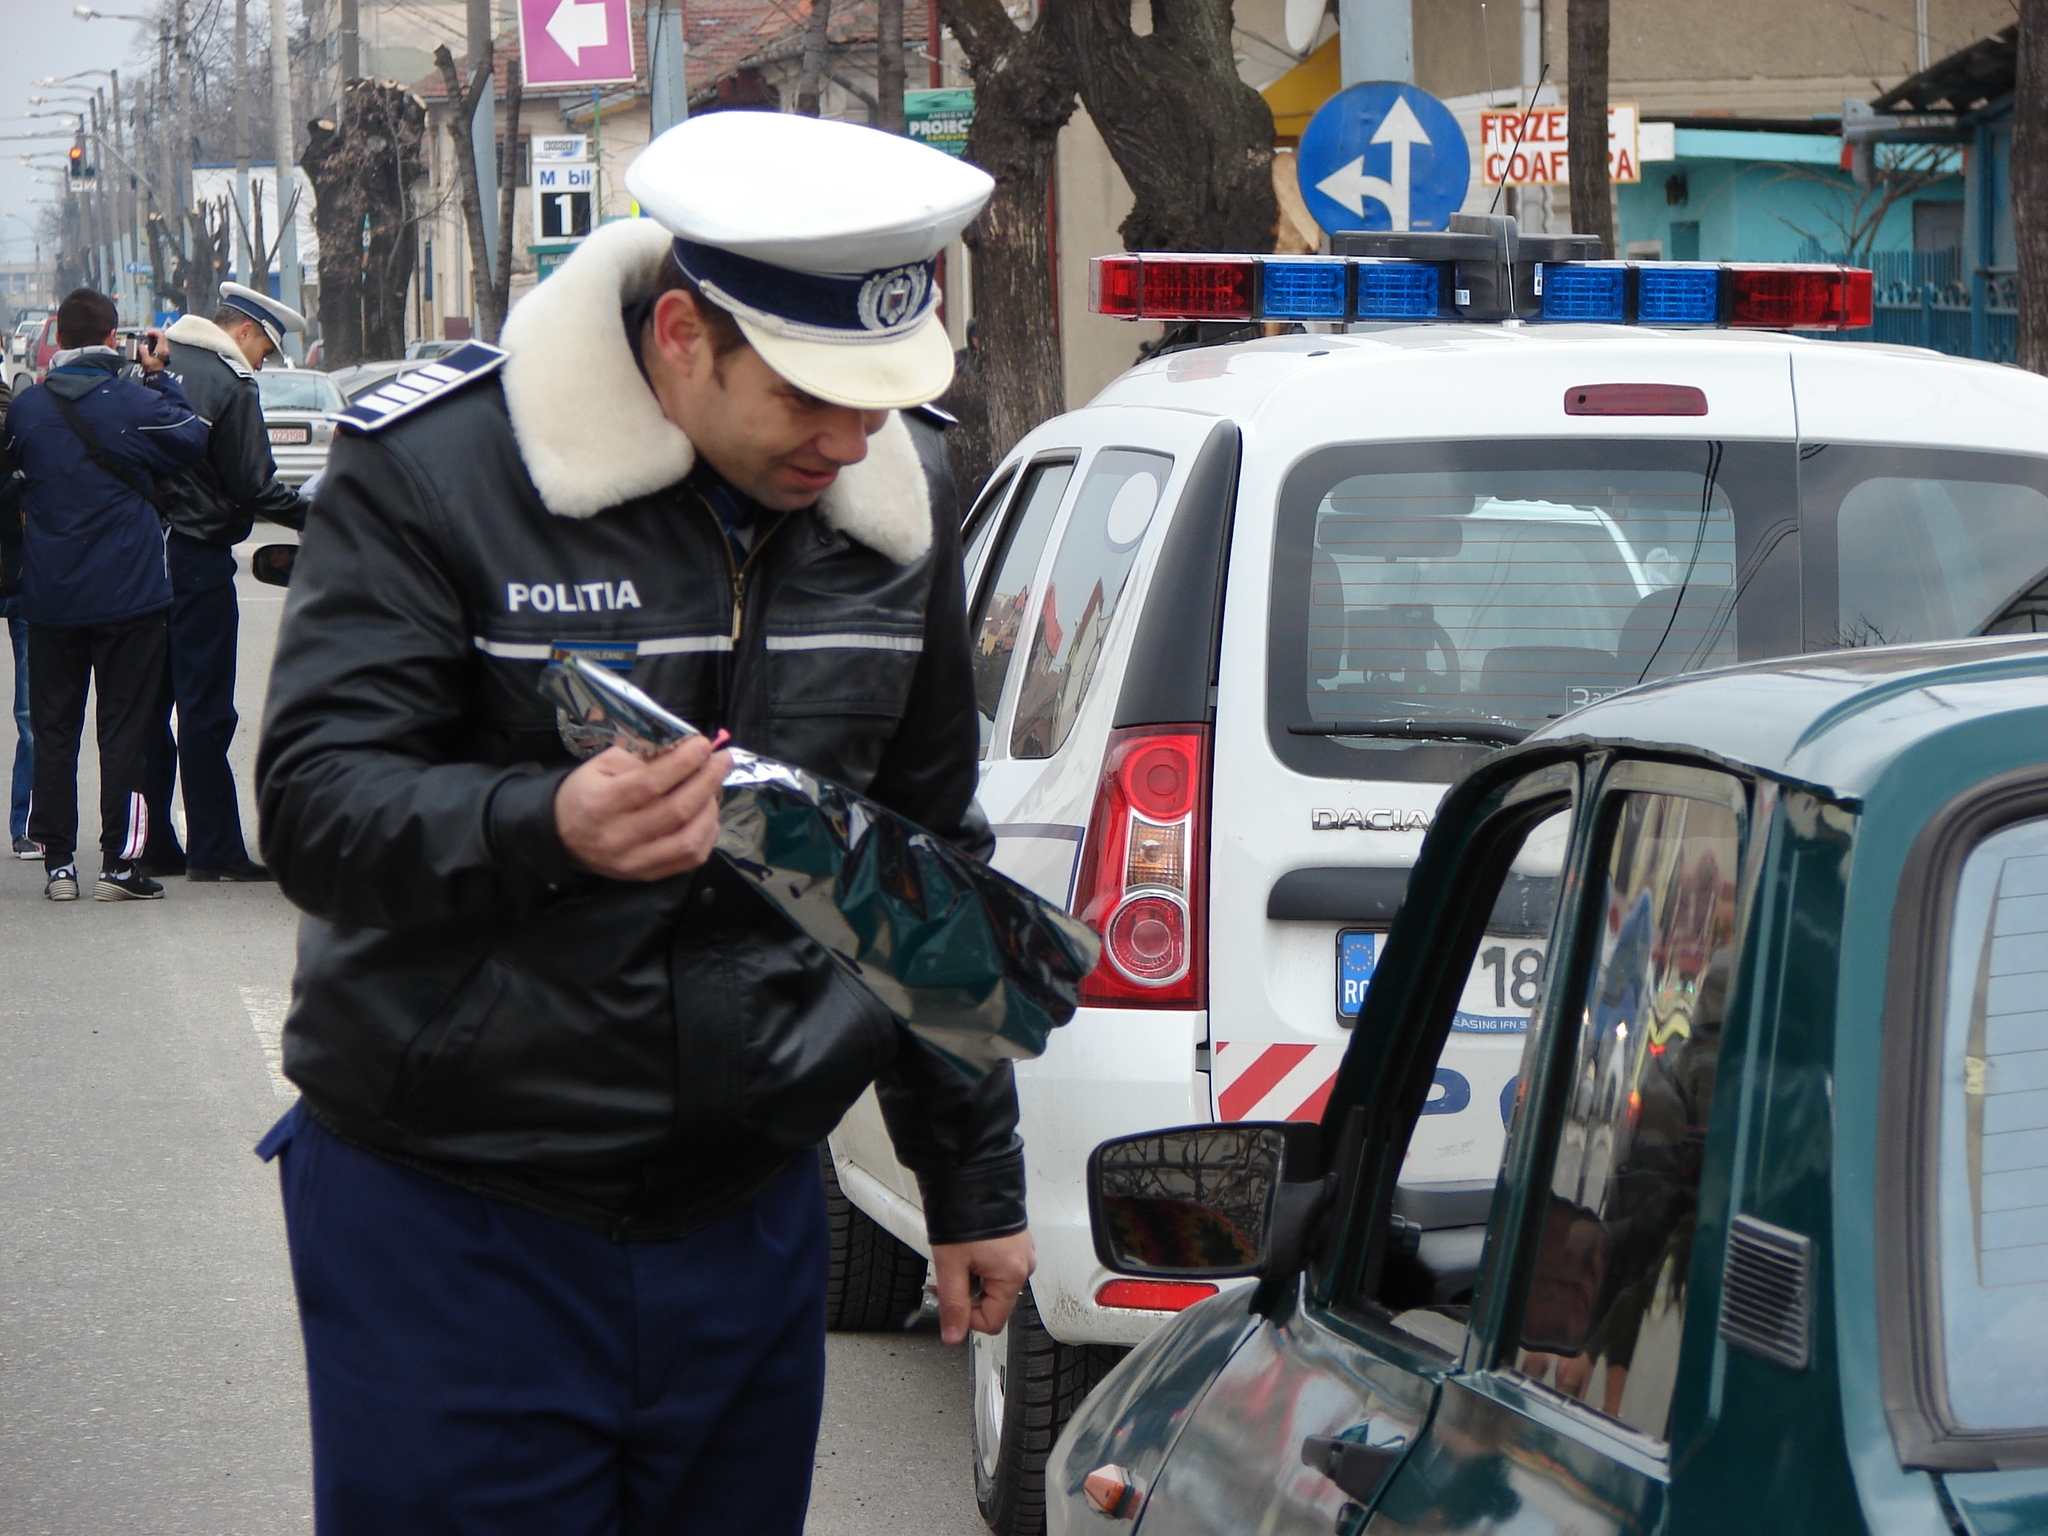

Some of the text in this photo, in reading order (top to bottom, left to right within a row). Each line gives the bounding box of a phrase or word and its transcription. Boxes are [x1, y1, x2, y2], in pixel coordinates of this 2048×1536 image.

[554, 193, 573, 236] 1
[507, 580, 642, 613] POLITIA
[1312, 807, 1430, 832] DACIA
[1453, 1016, 1497, 1030] EASING
[1500, 1020, 1517, 1030] IFN
